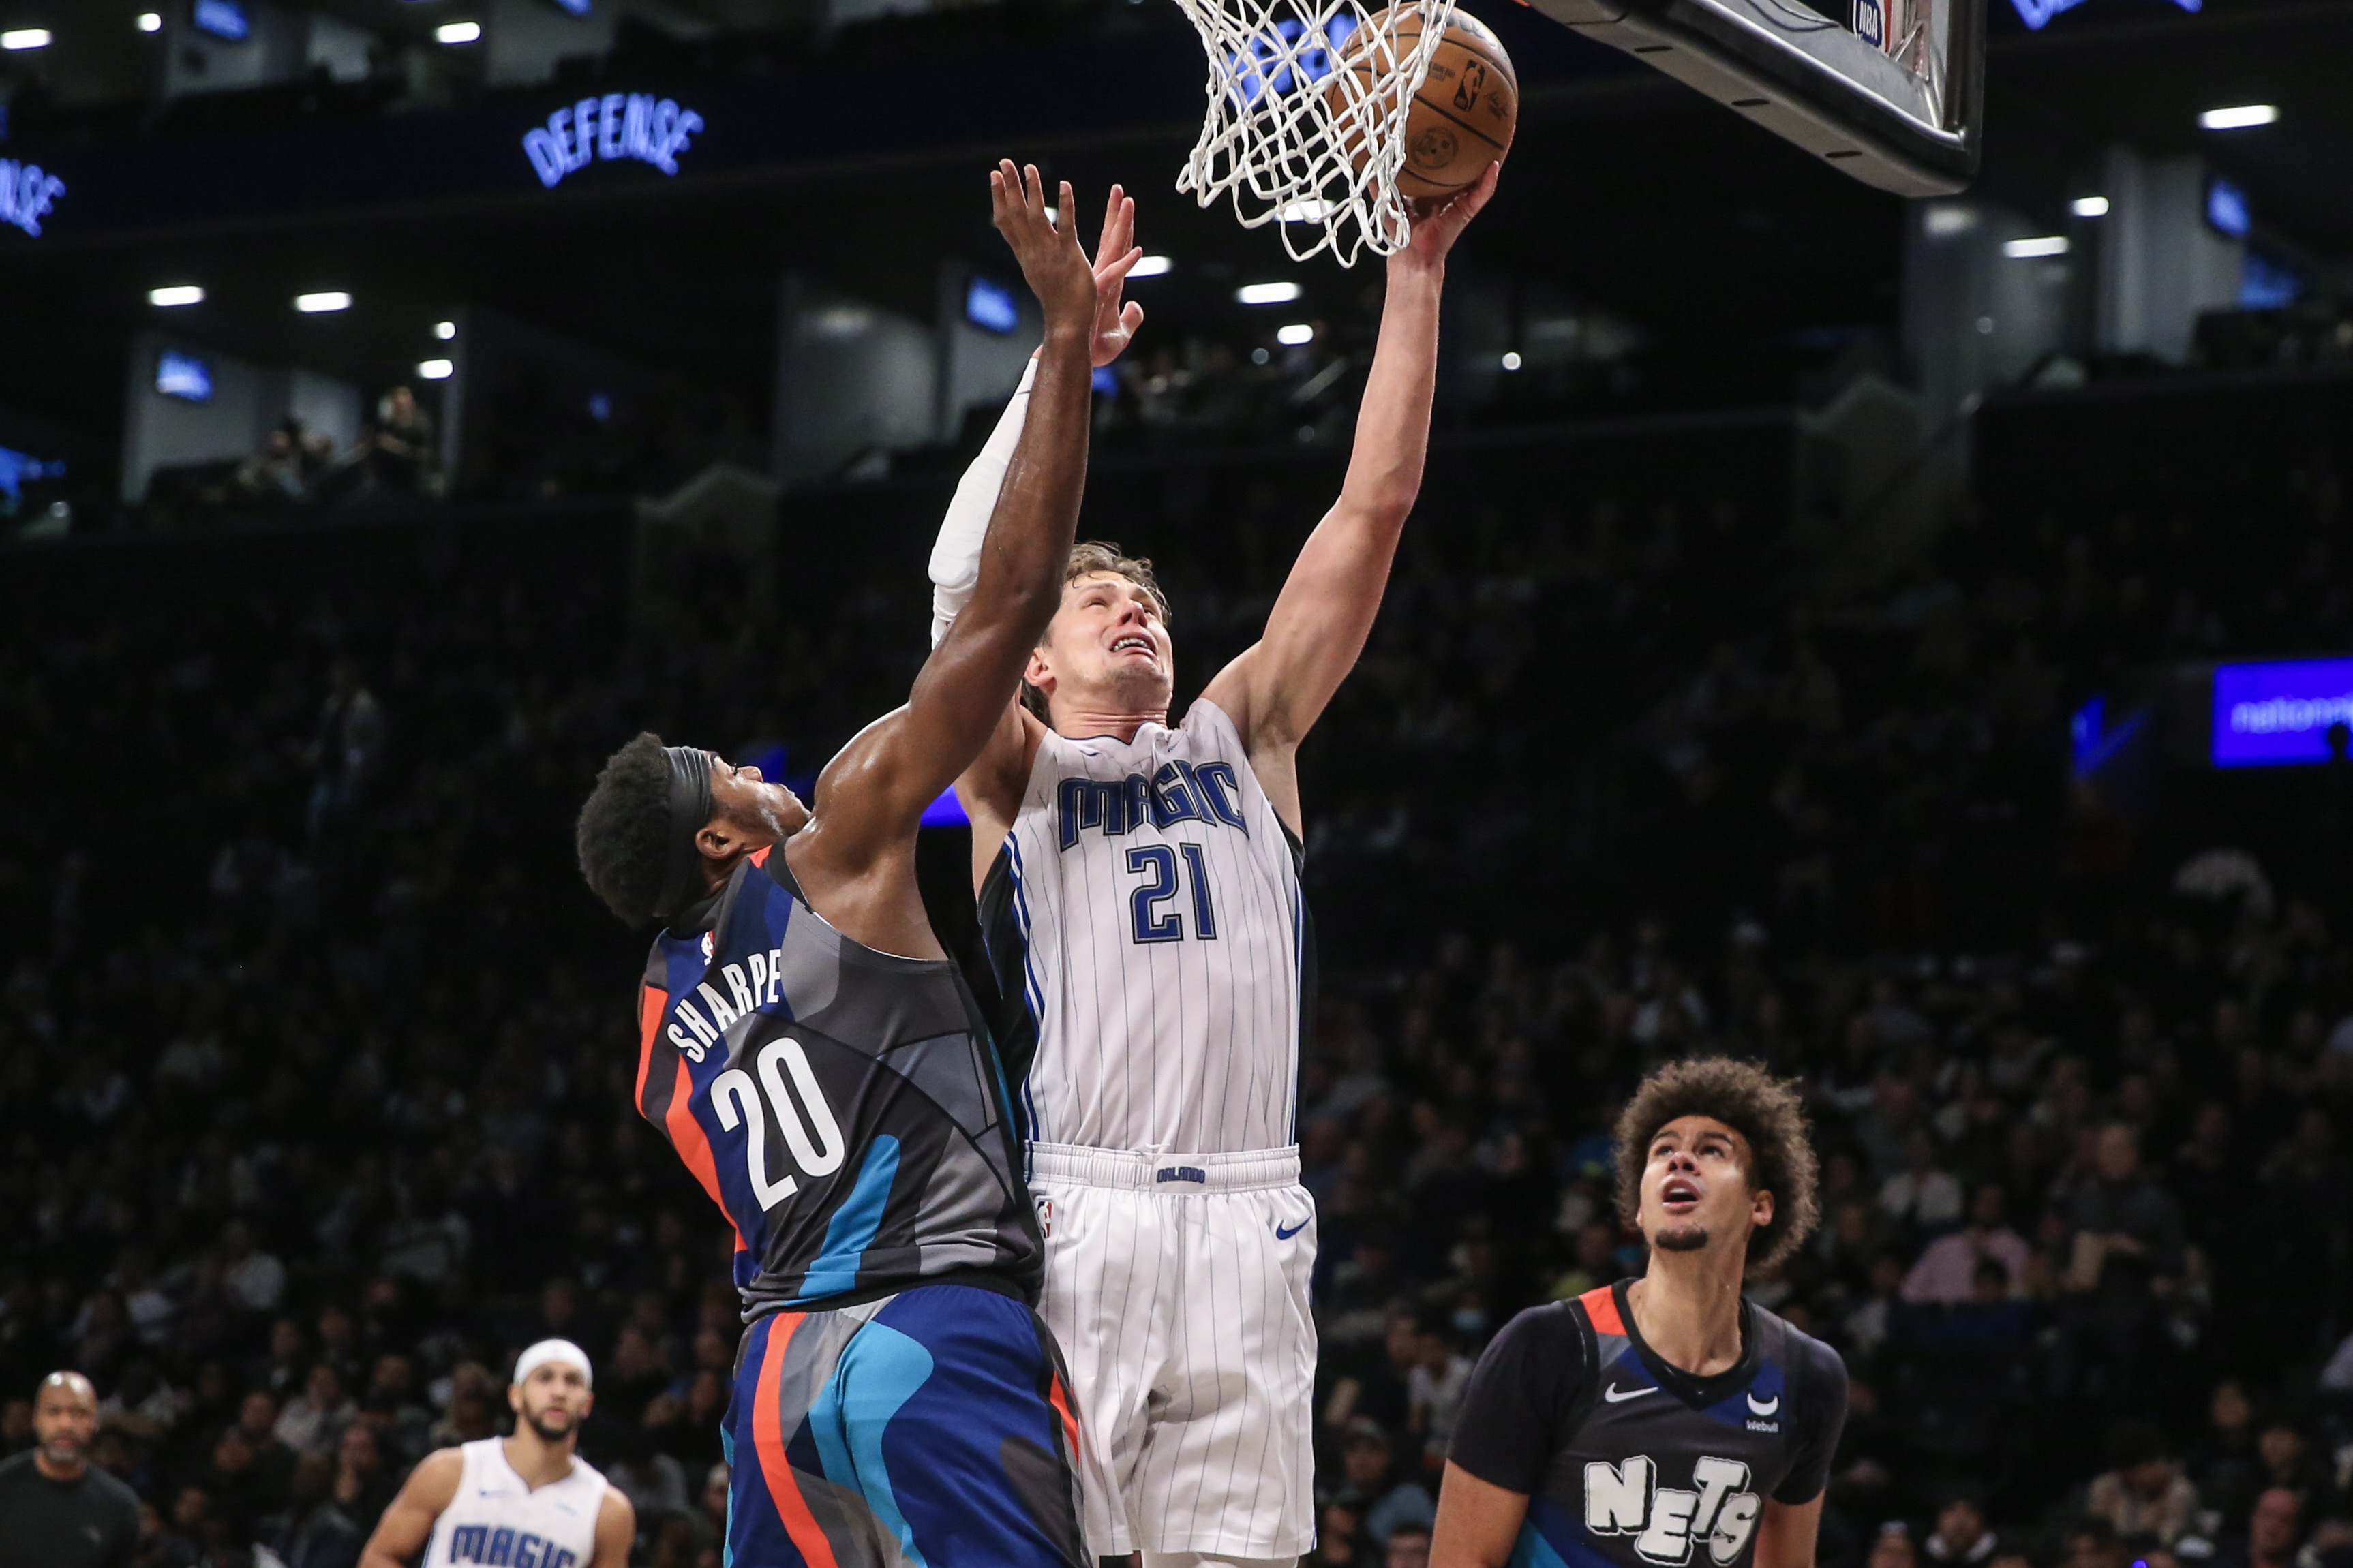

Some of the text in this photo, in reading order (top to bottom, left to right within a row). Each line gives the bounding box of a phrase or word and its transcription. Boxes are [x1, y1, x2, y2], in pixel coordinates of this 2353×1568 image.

[1859, 0, 1878, 40] NBA
[521, 92, 705, 188] DEFENSE
[1057, 760, 1249, 853] MAGIC
[1125, 842, 1217, 944] 21
[667, 949, 782, 1064] SHARPE
[710, 1036, 845, 1212] 20
[1157, 1166, 1205, 1184] ORLANDO
[450, 1524, 577, 1568] MAGIC
[1584, 1454, 1761, 1567] NETS
